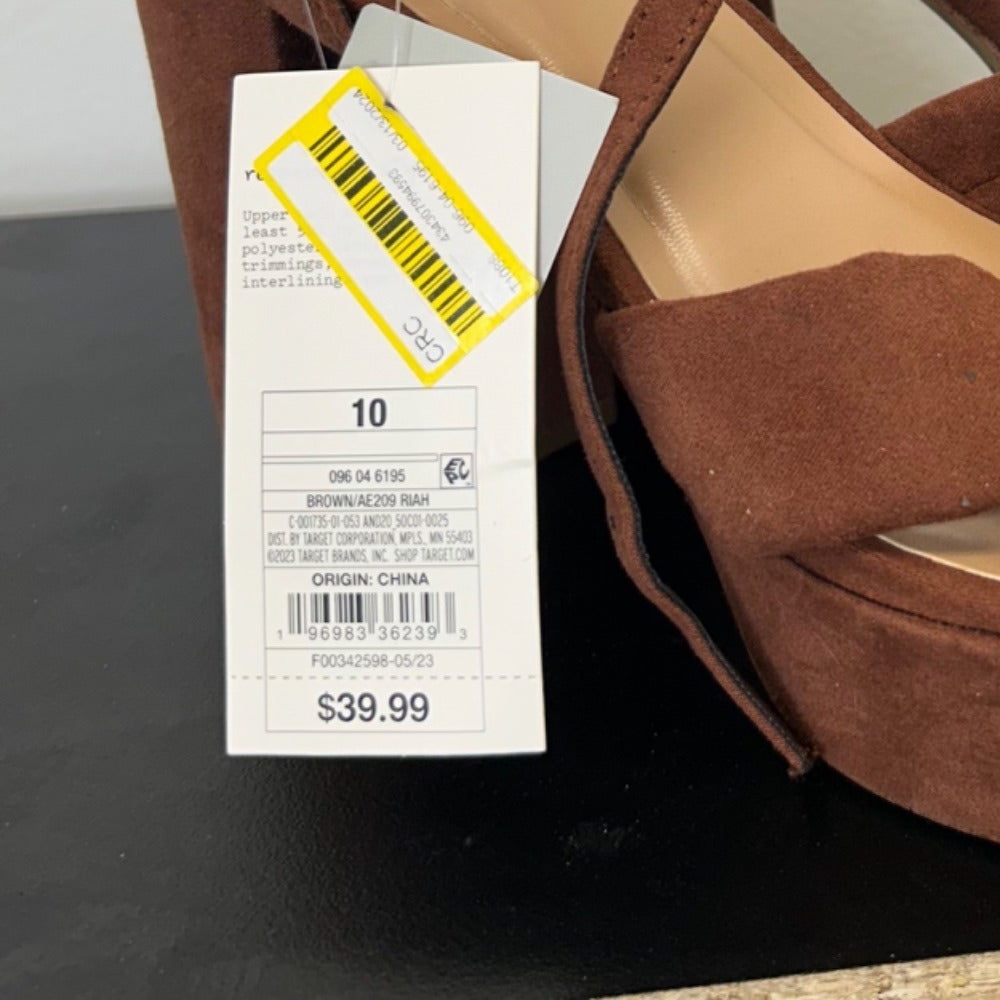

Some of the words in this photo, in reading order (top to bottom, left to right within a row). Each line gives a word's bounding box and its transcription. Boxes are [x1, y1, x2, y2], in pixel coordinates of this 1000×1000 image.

[243, 210, 289, 224] Upper
[244, 226, 287, 238] least
[242, 242, 319, 258] polyeste
[402, 315, 446, 364] CRC
[352, 398, 388, 427] 10
[329, 470, 352, 484] 096
[356, 469, 371, 483] 04
[374, 468, 406, 483] 6195
[306, 493, 397, 508] BROWN/AE209
[400, 493, 430, 507] RIAH
[290, 531, 300, 546] BY
[303, 531, 333, 545] TARGET
[430, 531, 443, 544] MN
[445, 530, 473, 544] 55403
[298, 548, 329, 562] TARGET
[394, 548, 418, 562] SHOP
[312, 572, 374, 586] ORIGIN:
[377, 572, 430, 586] CHINA
[308, 626, 366, 641] 96983
[378, 625, 438, 641] 36239
[459, 628, 468, 640] 3
[311, 653, 435, 668] F00342598-05/23
[317, 691, 430, 724] $39.99
